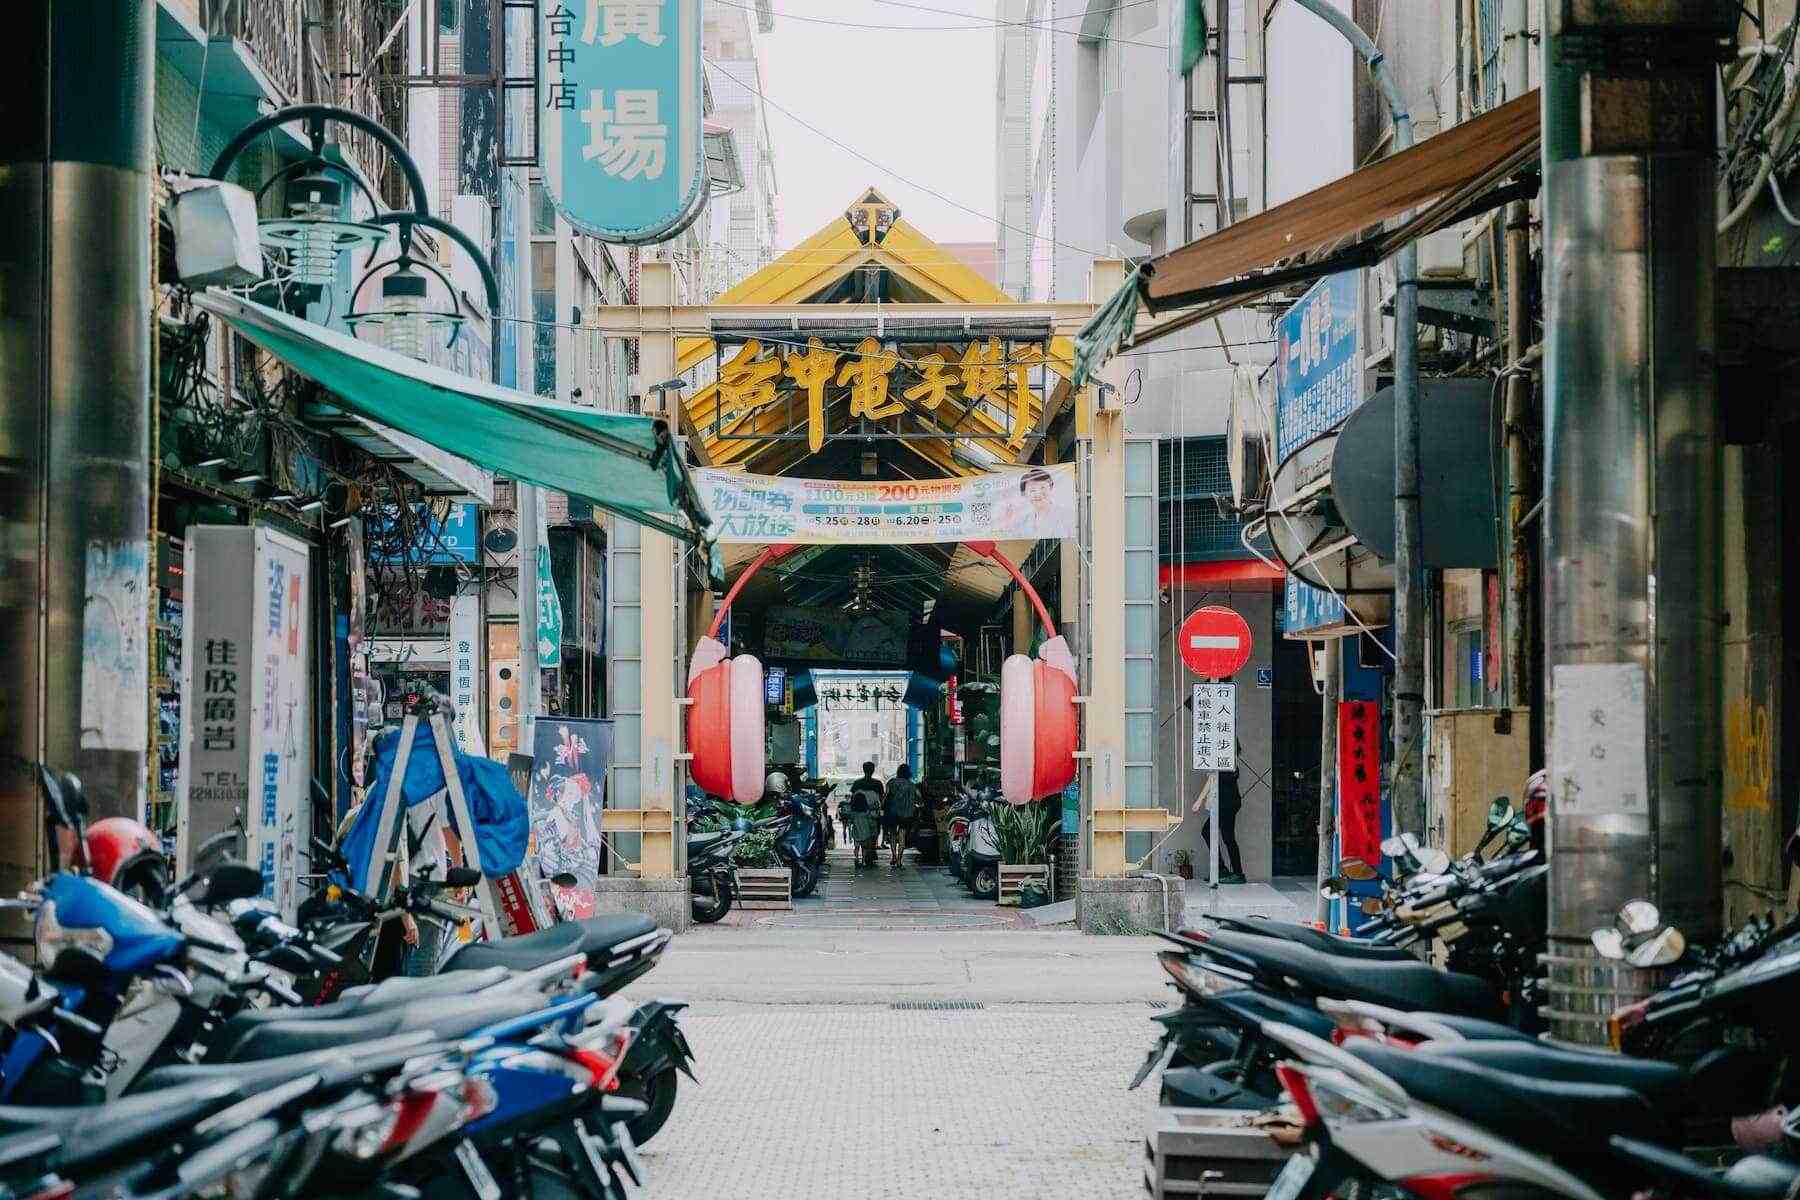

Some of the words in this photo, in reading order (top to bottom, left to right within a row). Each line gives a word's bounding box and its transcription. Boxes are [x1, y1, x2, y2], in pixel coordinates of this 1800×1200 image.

[545, 4, 578, 111] 台中店
[580, 0, 669, 181] 廣場
[718, 336, 1046, 454] 台中電子街
[201, 771, 246, 786] TEL
[1216, 687, 1232, 768] 行人徒步區
